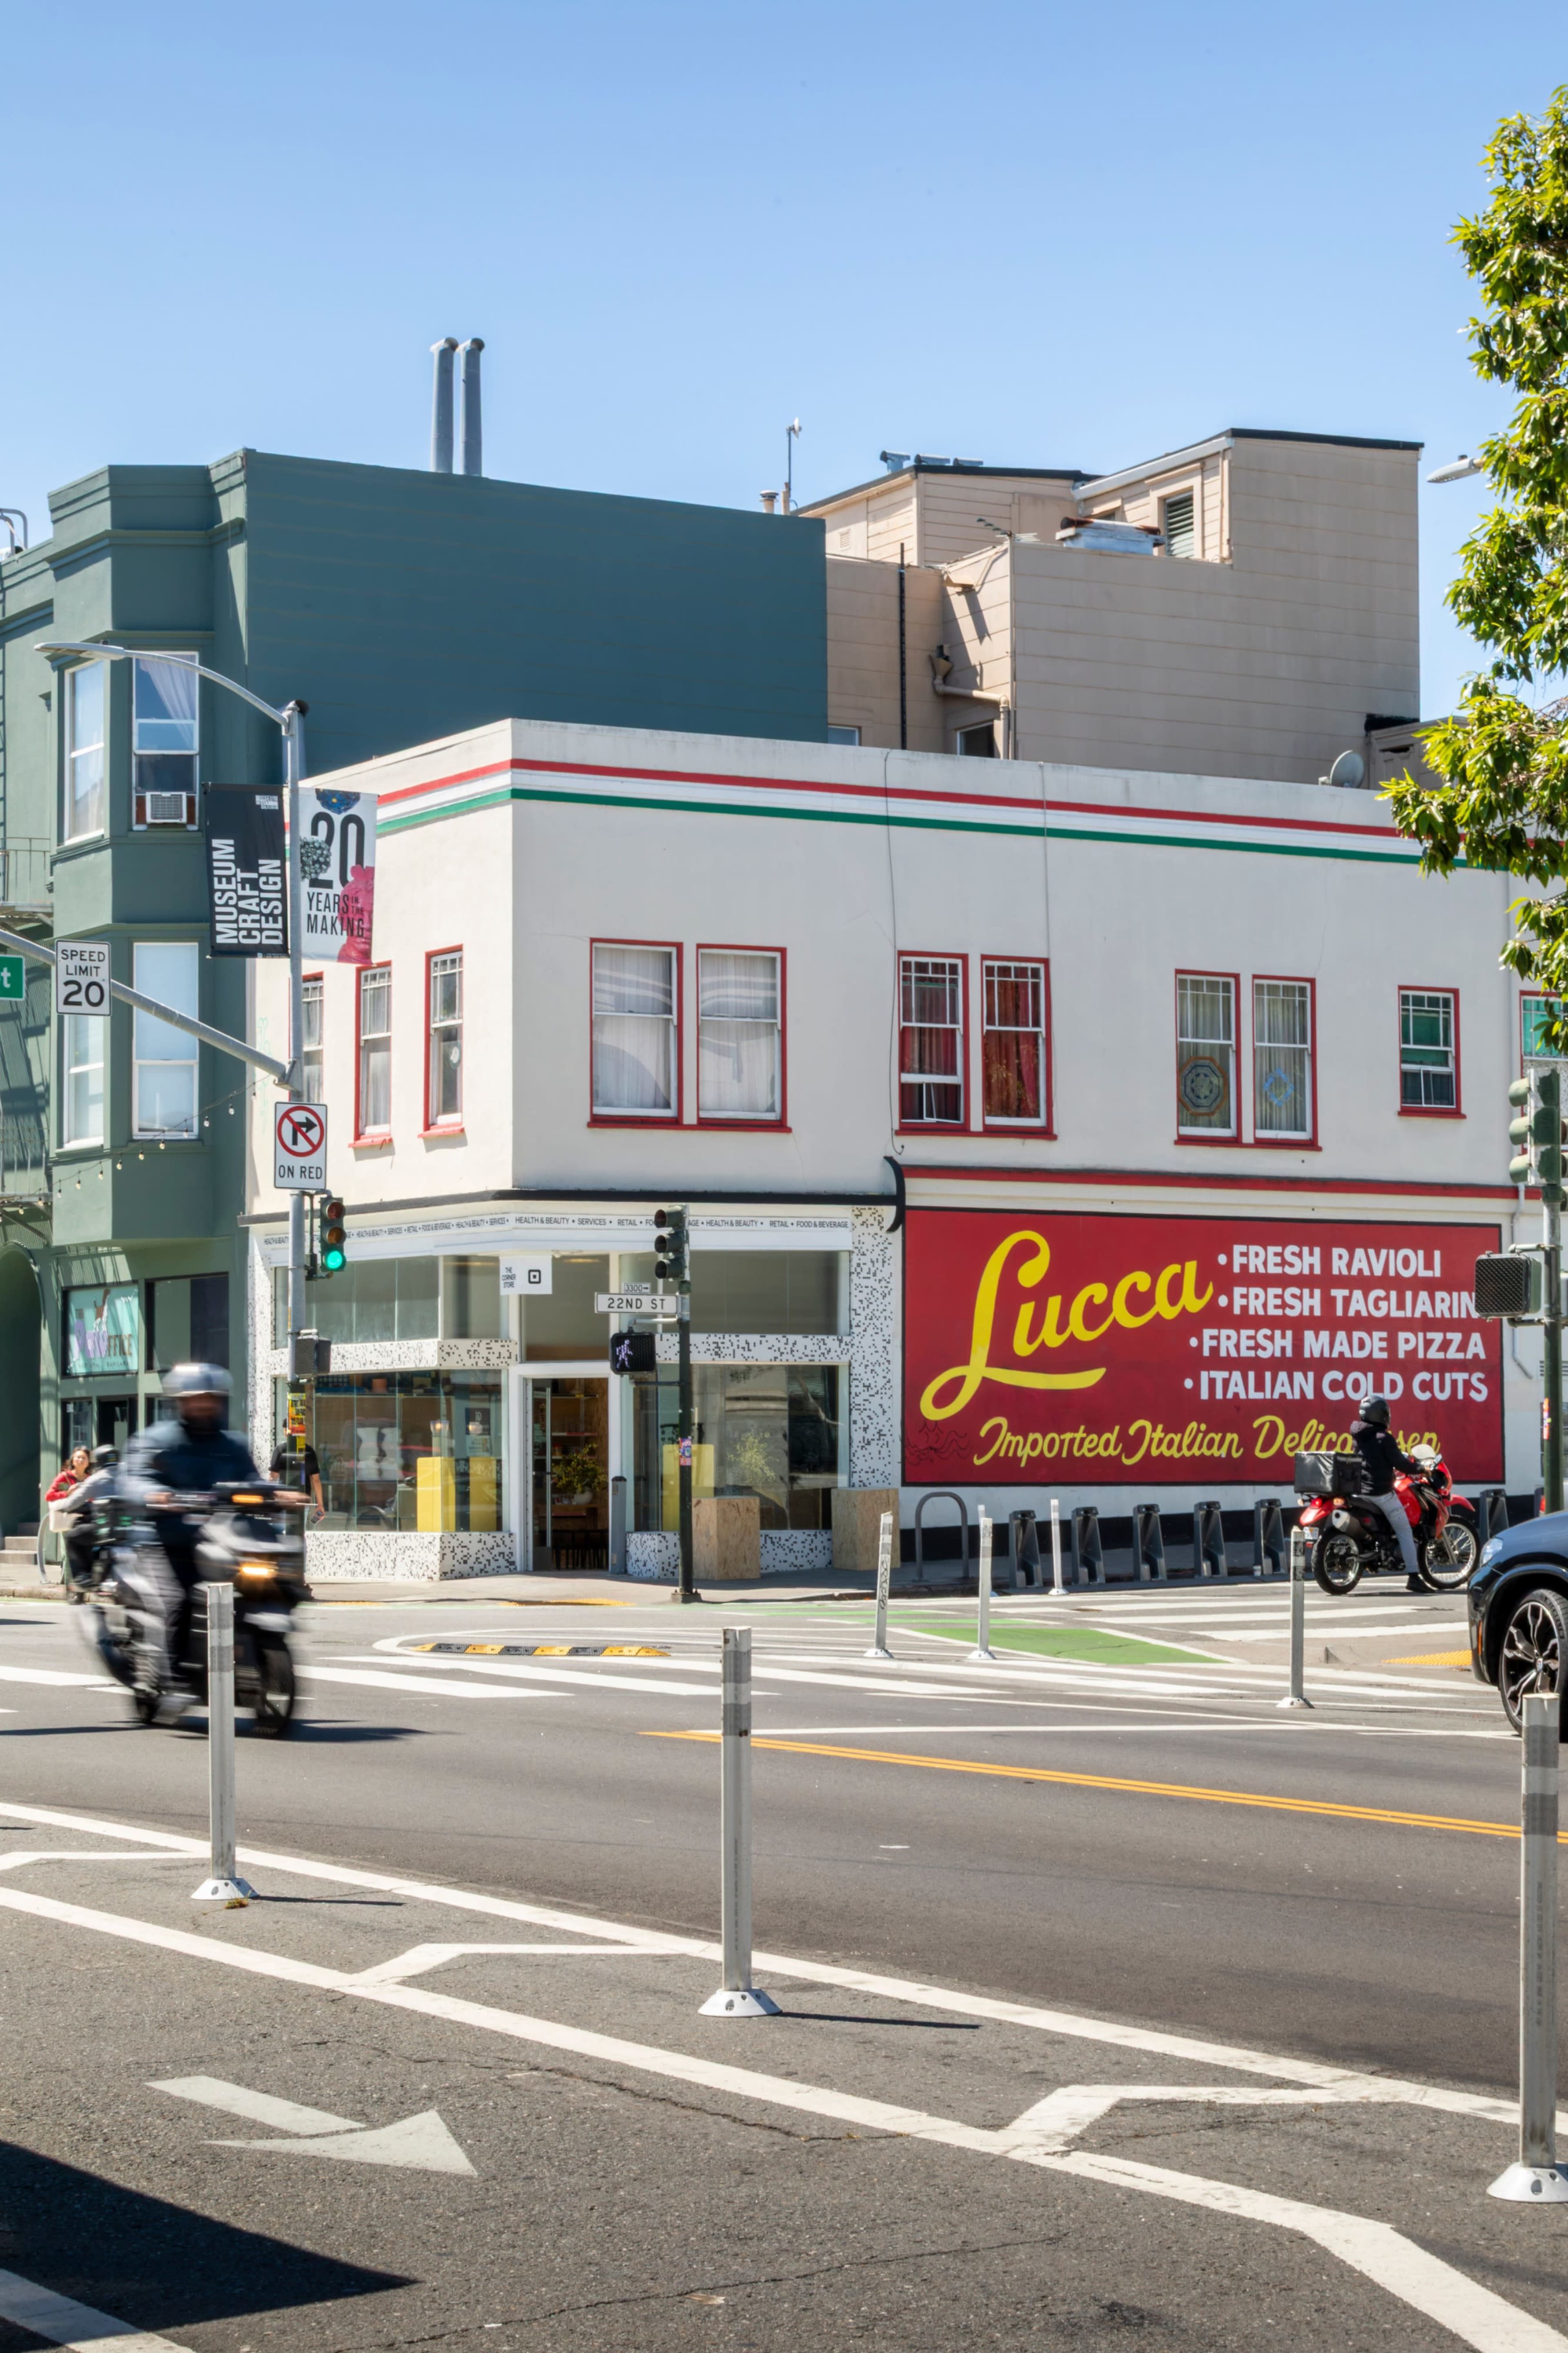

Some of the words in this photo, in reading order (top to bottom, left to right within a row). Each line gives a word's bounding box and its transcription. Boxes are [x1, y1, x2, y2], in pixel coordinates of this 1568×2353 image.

[309, 812, 365, 890] 20
[212, 839, 238, 943] MUSEUM
[258, 859, 283, 945] DESIGN
[307, 891, 349, 914] YEARS
[236, 868, 261, 944] CRAFT
[352, 905, 364, 915] THE
[307, 913, 364, 938] MAKING
[61, 949, 105, 962] SPEED
[0, 967, 11, 988] t
[66, 964, 101, 977] LIMIT
[63, 980, 105, 1007] 20
[278, 1164, 294, 1178] ON
[300, 1166, 323, 1179] RED
[472, 1219, 485, 1227] BEAUTY
[490, 1217, 506, 1226] SERVICES
[1233, 1245, 1321, 1275] FRESH
[1332, 1248, 1441, 1277] RAVIOLI
[608, 1298, 642, 1309] 22ND
[651, 1299, 666, 1309] ST
[1233, 1287, 1321, 1316] FRESH
[1330, 1289, 1479, 1318] TAGLIARIN
[920, 1231, 1214, 1421] Lucca
[1202, 1329, 1292, 1358] FRESH
[1303, 1331, 1387, 1359] MADE
[1398, 1332, 1486, 1360] PIZZA
[1200, 1370, 1314, 1399] ITALIAN
[1322, 1371, 1403, 1400] COLD
[1412, 1372, 1488, 1402] CUTS
[973, 1416, 1122, 1467] Imported
[1121, 1419, 1243, 1465] Italian
[1253, 1415, 1440, 1459] Delicasen
